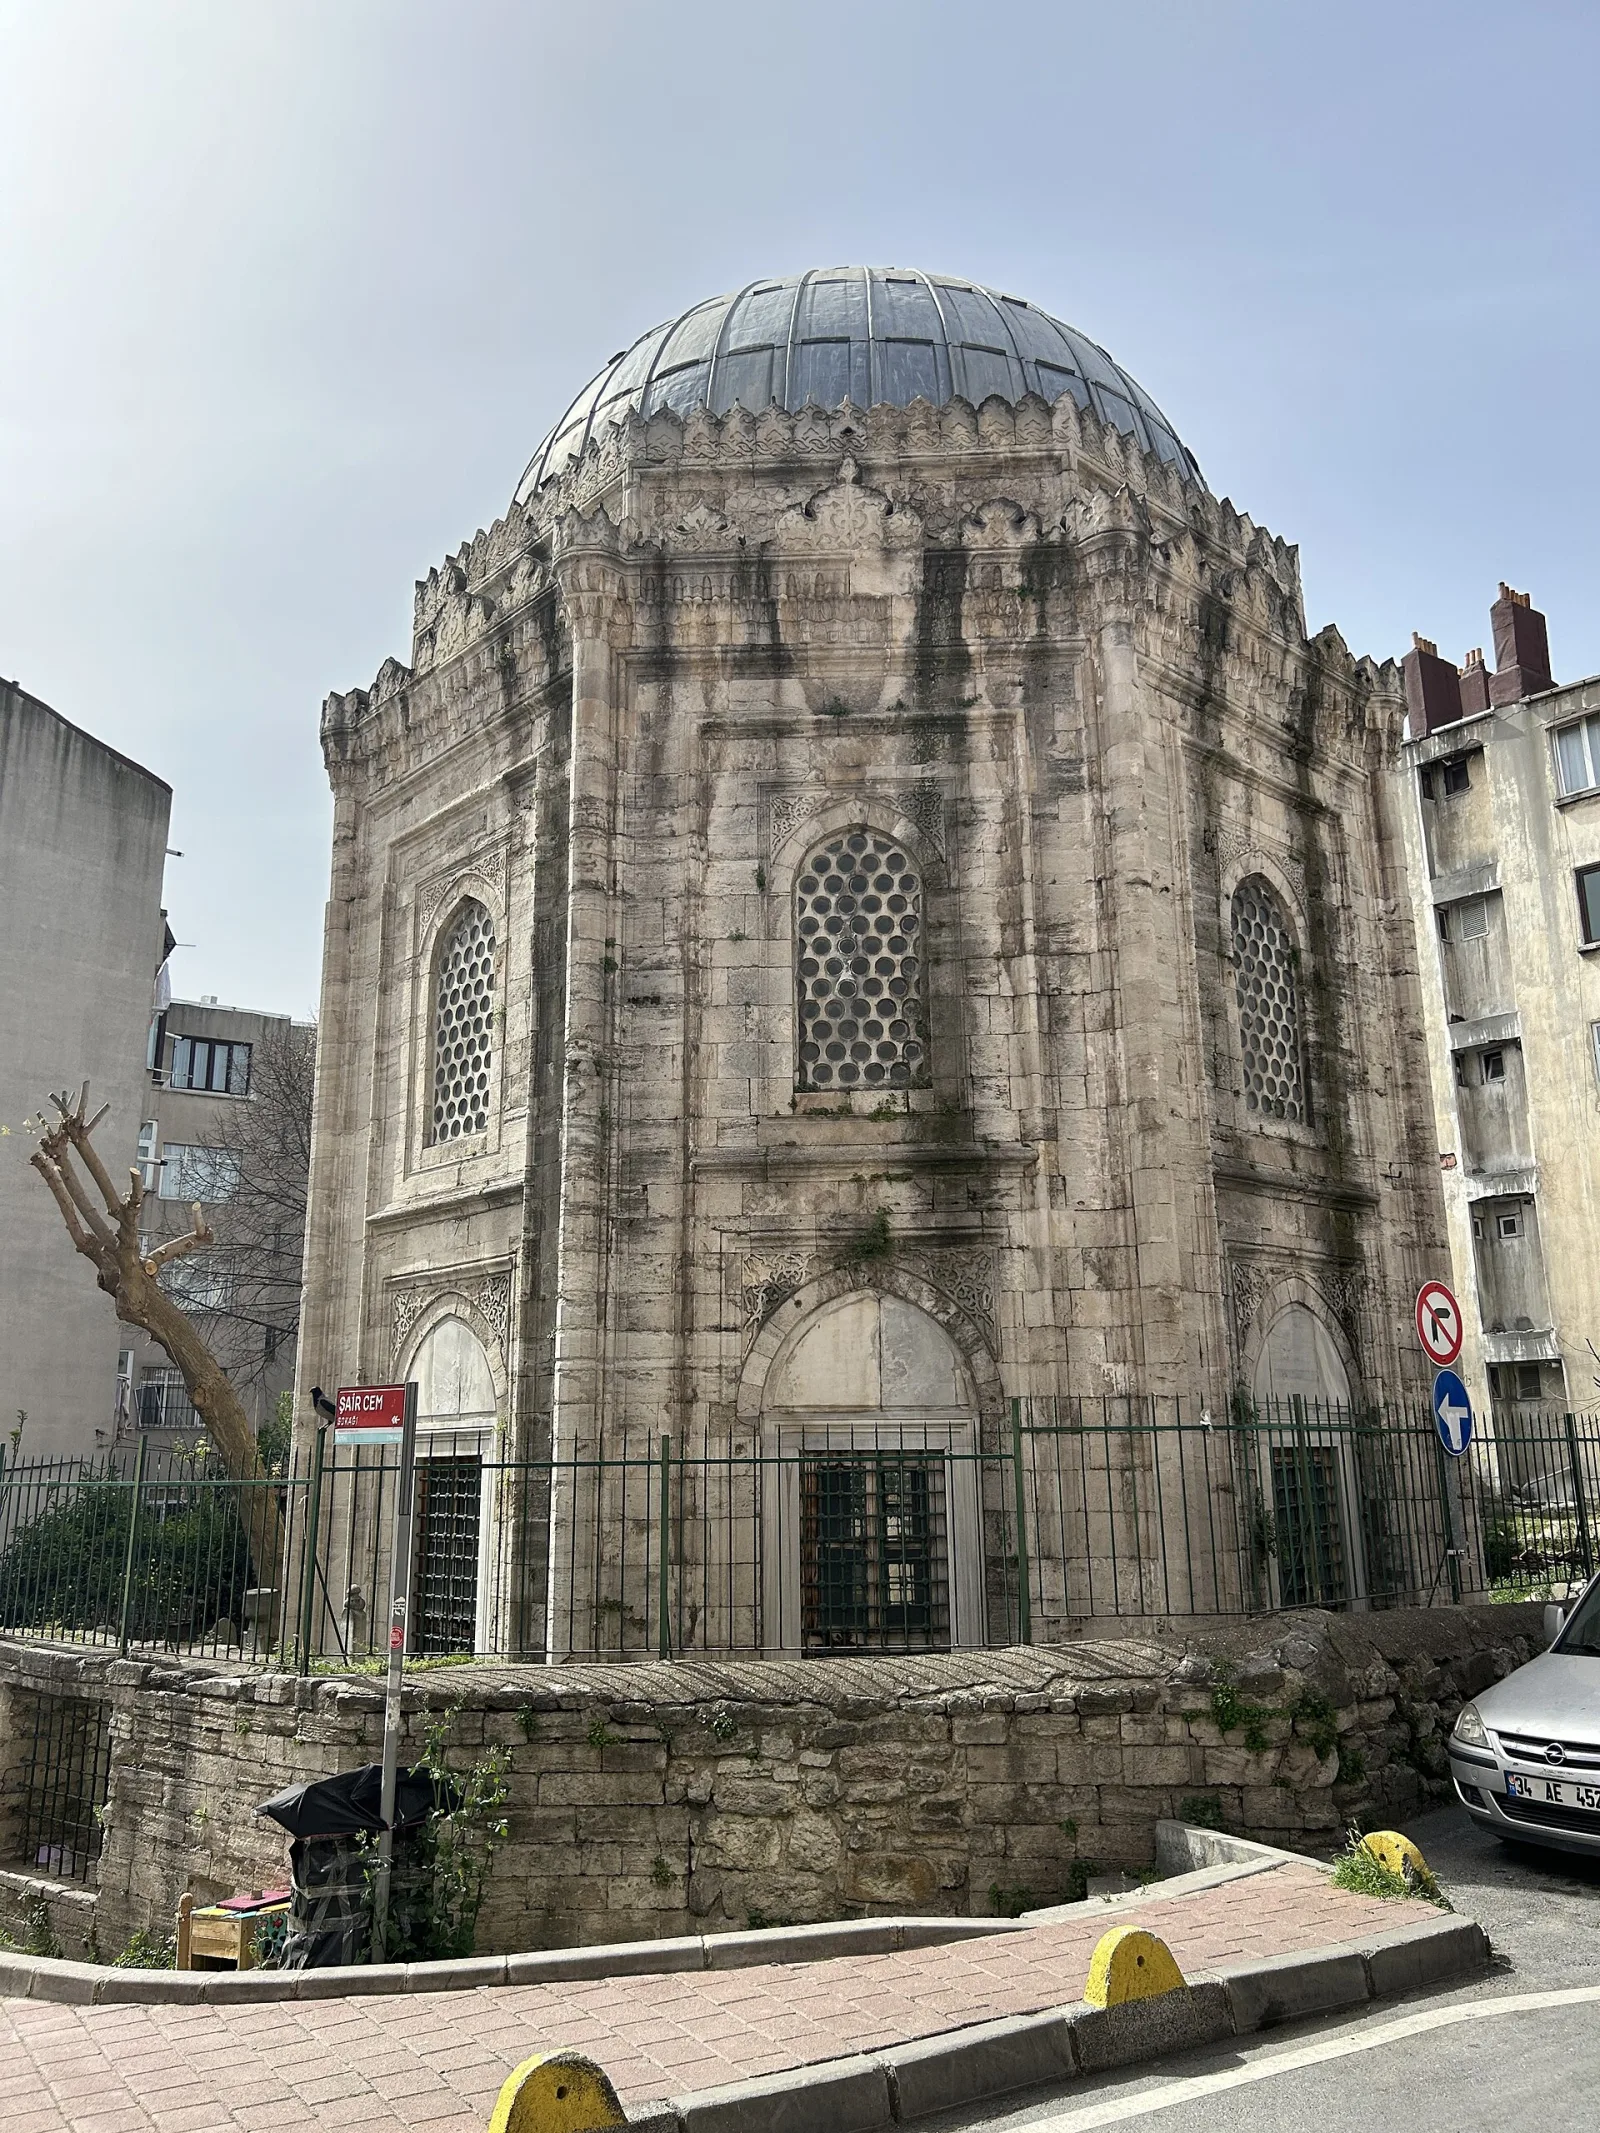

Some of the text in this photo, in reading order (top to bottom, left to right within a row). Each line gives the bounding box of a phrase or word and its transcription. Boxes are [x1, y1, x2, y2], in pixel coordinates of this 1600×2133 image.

[339, 1393, 383, 1414] ŞAİR CEM
[1515, 1777, 1532, 1796] 34
[1546, 1782, 1563, 1803] AE
